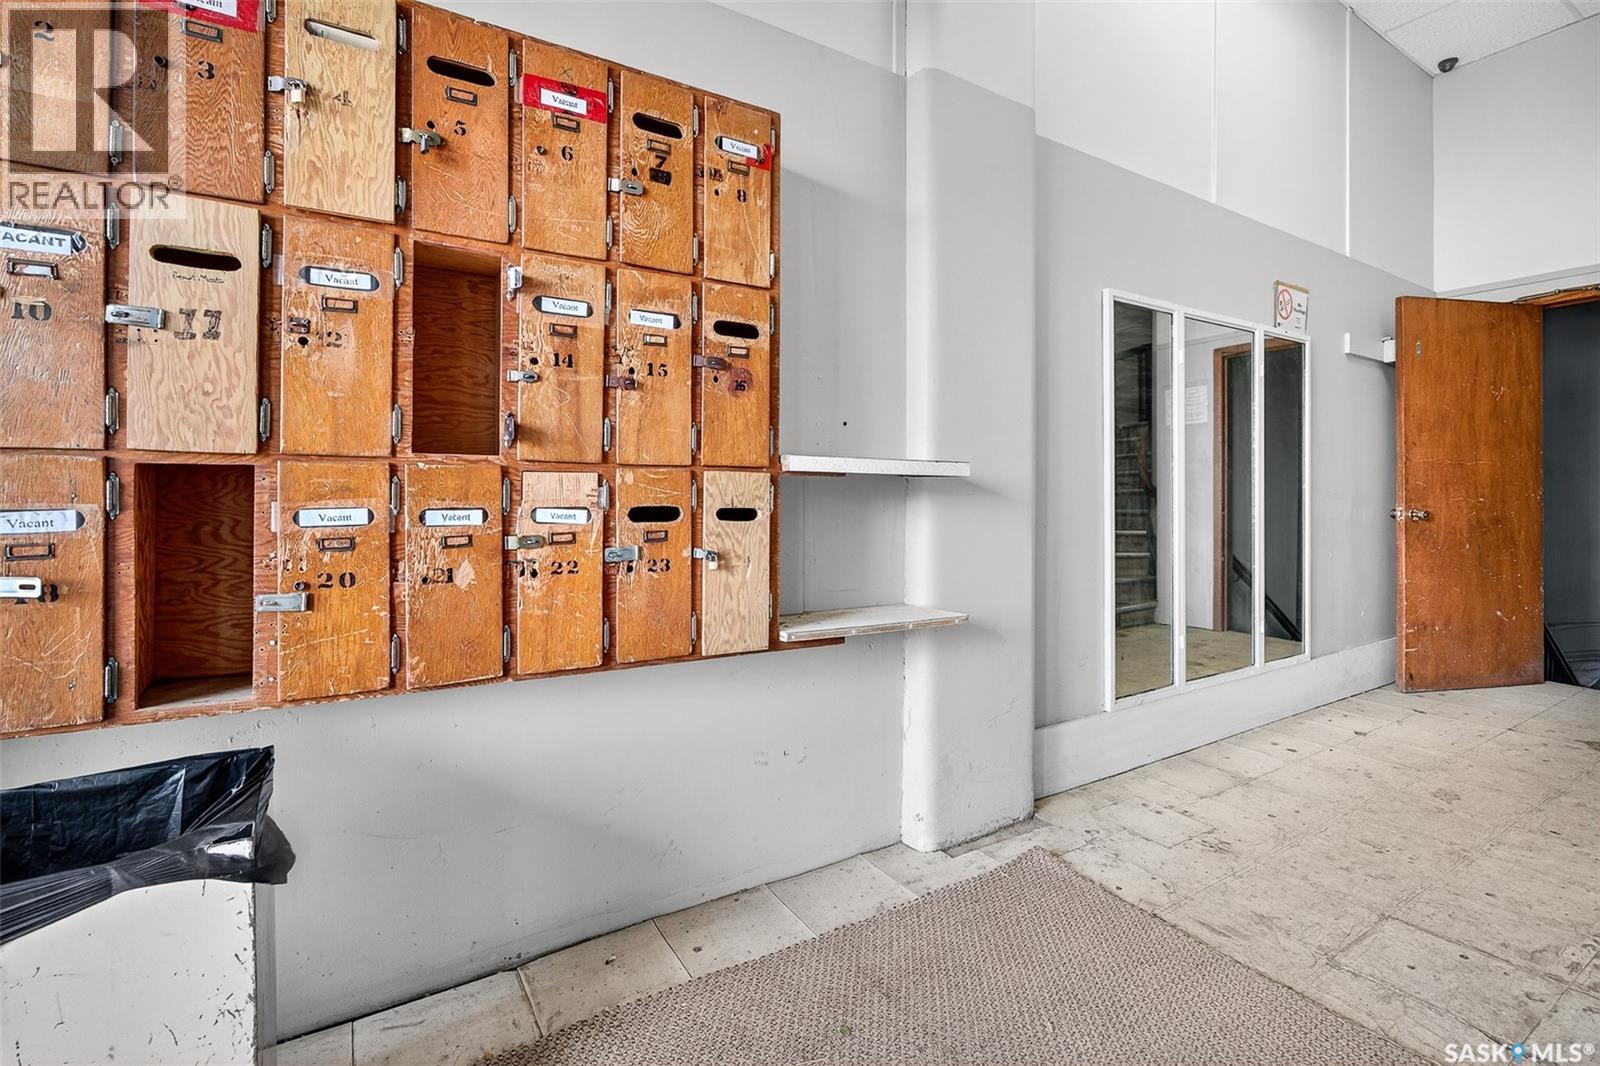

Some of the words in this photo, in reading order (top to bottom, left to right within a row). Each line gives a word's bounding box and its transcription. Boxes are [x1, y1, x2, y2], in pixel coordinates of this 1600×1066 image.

[197, 60, 215, 80] 3
[454, 120, 467, 136] 5
[561, 145, 573, 162] 6
[655, 154, 668, 168] 7
[736, 189, 747, 203] 8
[325, 274, 360, 287] Vacant
[552, 300, 579, 312] Vacant
[639, 313, 664, 325] Vacant
[552, 352, 573, 369] 14
[646, 362, 668, 378] 15
[318, 512, 353, 523] Vacant
[441, 512, 471, 523] Vacant
[549, 511, 577, 522] Vacant
[6, 518, 54, 530] Vacant
[550, 560, 579, 576] 22
[647, 558, 671, 574] 23
[316, 571, 357, 589] 20
